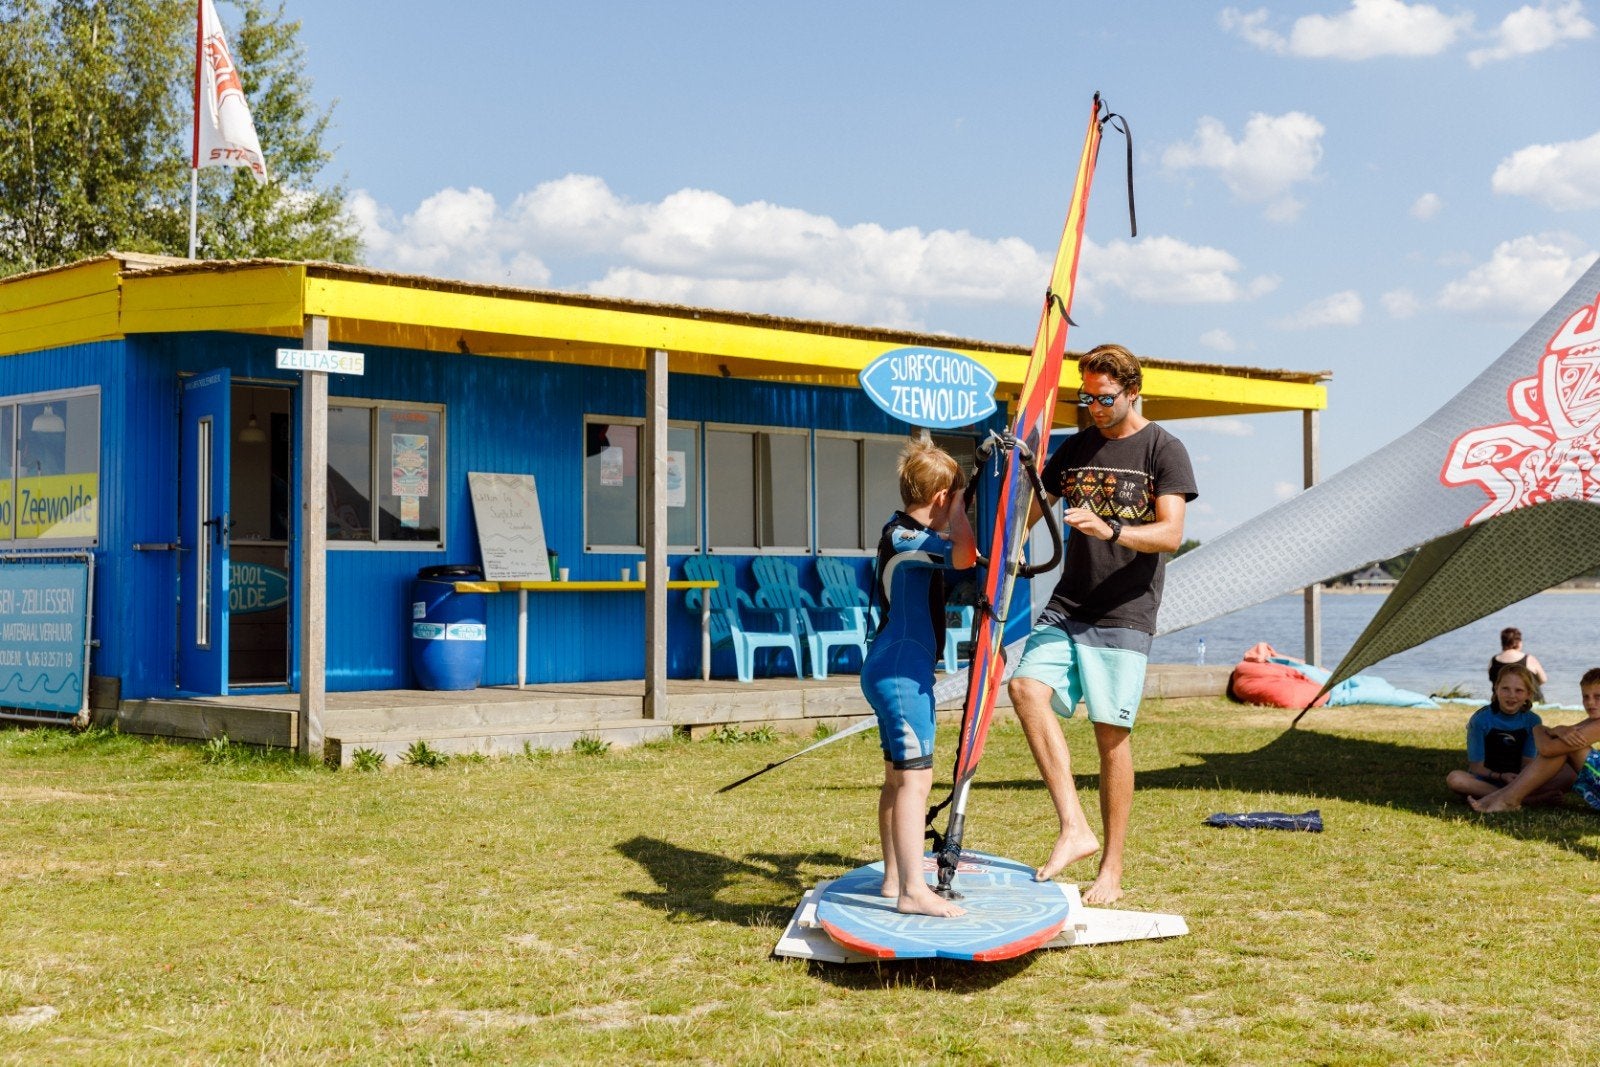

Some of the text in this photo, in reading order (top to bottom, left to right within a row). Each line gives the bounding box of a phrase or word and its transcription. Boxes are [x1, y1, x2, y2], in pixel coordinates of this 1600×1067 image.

[890, 354, 978, 386] SURFSCHOOL
[891, 385, 979, 421] ZEEWOLDE
[21, 484, 92, 526] Zeewolde
[39, 622, 73, 641] VERHUUR
